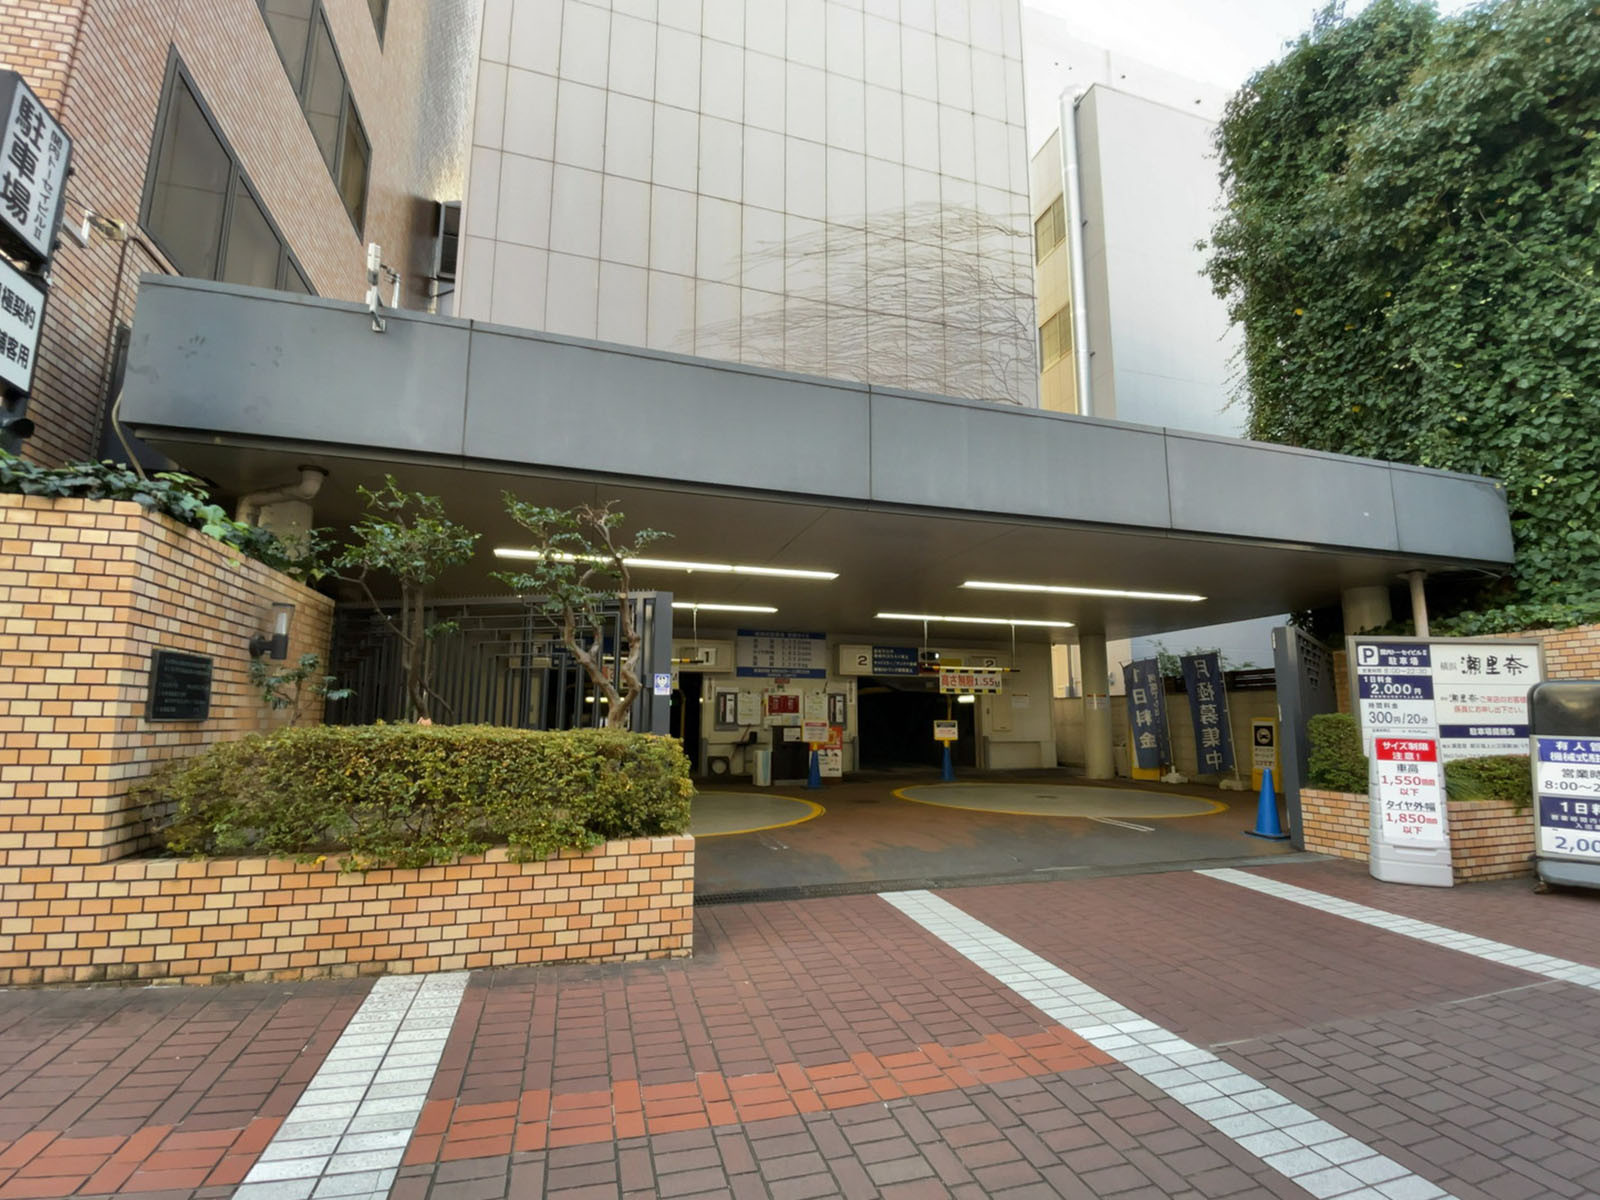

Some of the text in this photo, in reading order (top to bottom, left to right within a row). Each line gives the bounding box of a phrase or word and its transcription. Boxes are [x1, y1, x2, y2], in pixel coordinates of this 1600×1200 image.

[0, 94, 46, 226] 駐車場
[0, 282, 36, 330] 極契約
[703, 651, 710, 662] 1
[857, 655, 868, 666] 2
[1362, 648, 1374, 663] P
[1388, 656, 1419, 666] 駐車場
[1383, 742, 1429, 751] サイズ制限
[1397, 764, 1418, 773] 車高
[1400, 788, 1419, 796] 以下
[1386, 800, 1436, 812] タイヤ外幅
[1403, 826, 1423, 834] 以下
